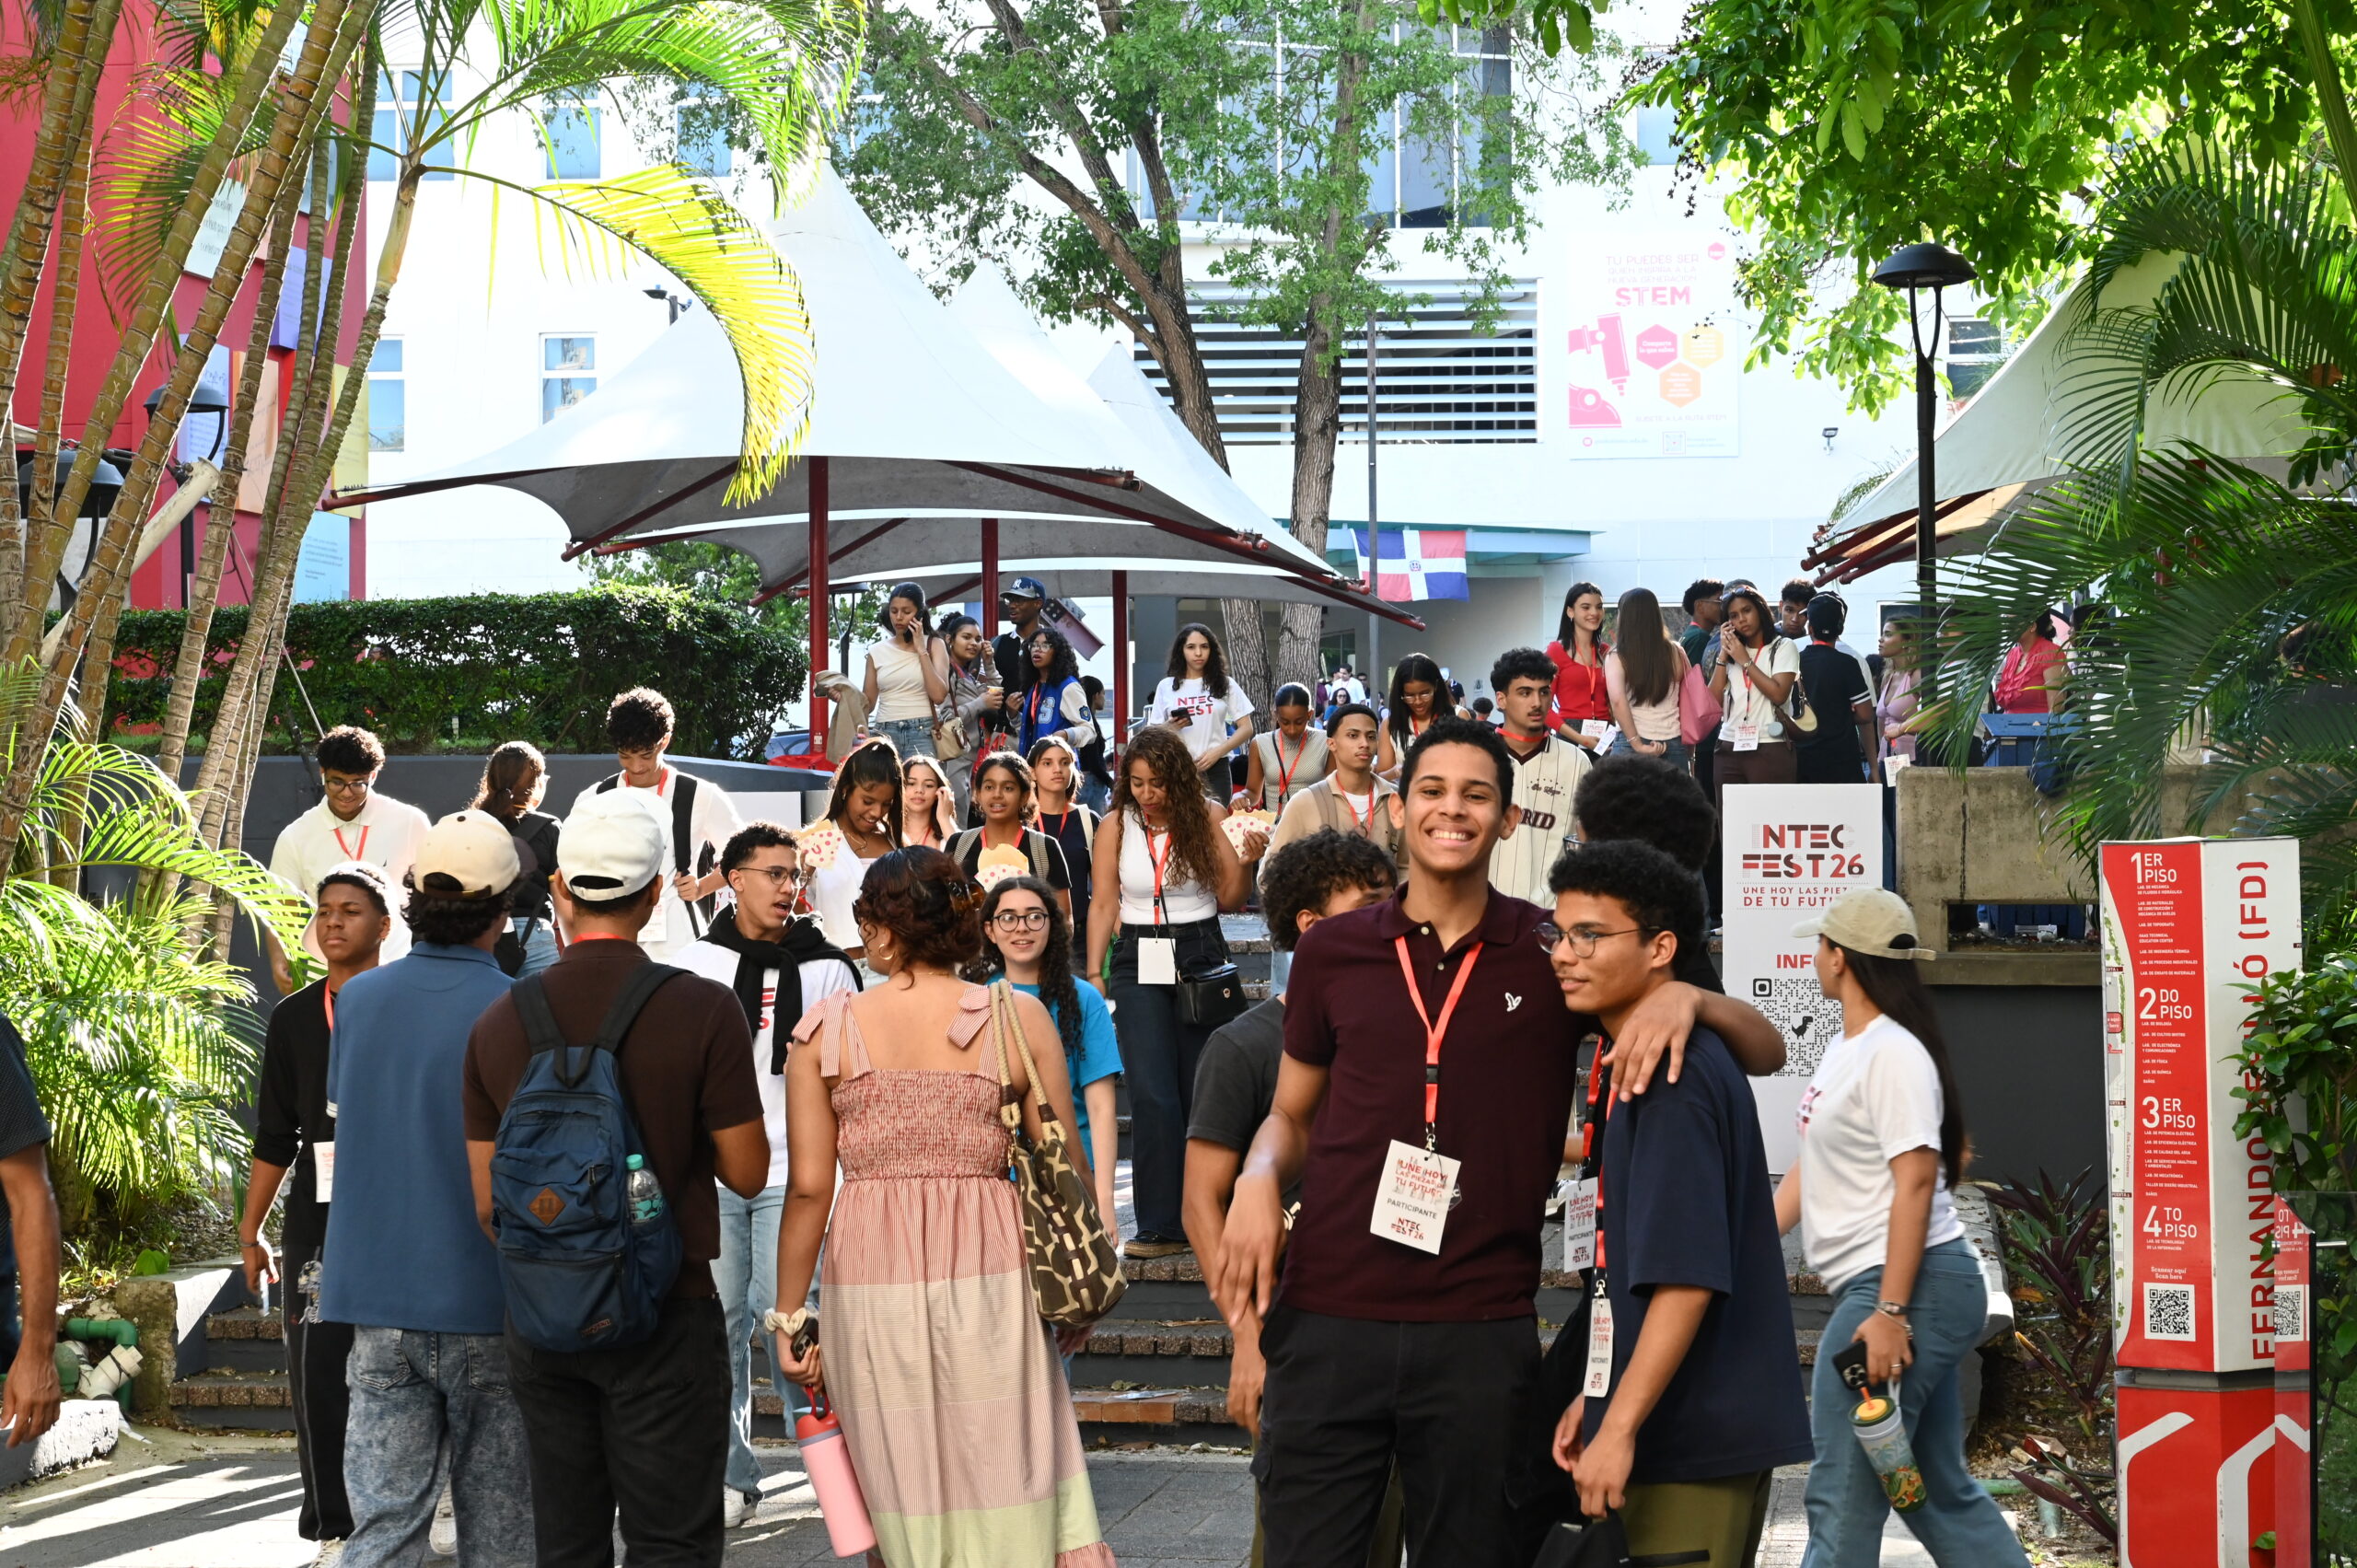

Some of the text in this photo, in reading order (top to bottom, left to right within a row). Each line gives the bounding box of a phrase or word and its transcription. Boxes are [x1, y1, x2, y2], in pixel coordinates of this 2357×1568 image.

[1626, 254, 1672, 265] PUEDES
[1677, 253, 1699, 263] SER
[1615, 285, 1691, 307] STEM
[1186, 703, 1213, 716] EST
[1517, 807, 1556, 830] RID
[1742, 854, 1865, 878] FEST 26
[2144, 868, 2177, 883] PISO
[1744, 897, 1833, 907] DE TU FUT
[2236, 861, 2270, 939] (FD)
[1776, 954, 1817, 969] INF
[2160, 1005, 2193, 1019] PISO
[2163, 1114, 2196, 1129] PISO
[1396, 1177, 1406, 1186] TU
[1387, 1198, 1437, 1219] PARTICIPANTE
[1390, 1223, 1424, 1241] FEST 26
[1568, 1230, 1594, 1241] PARTICIPANTE
[2165, 1223, 2198, 1238] PISO
